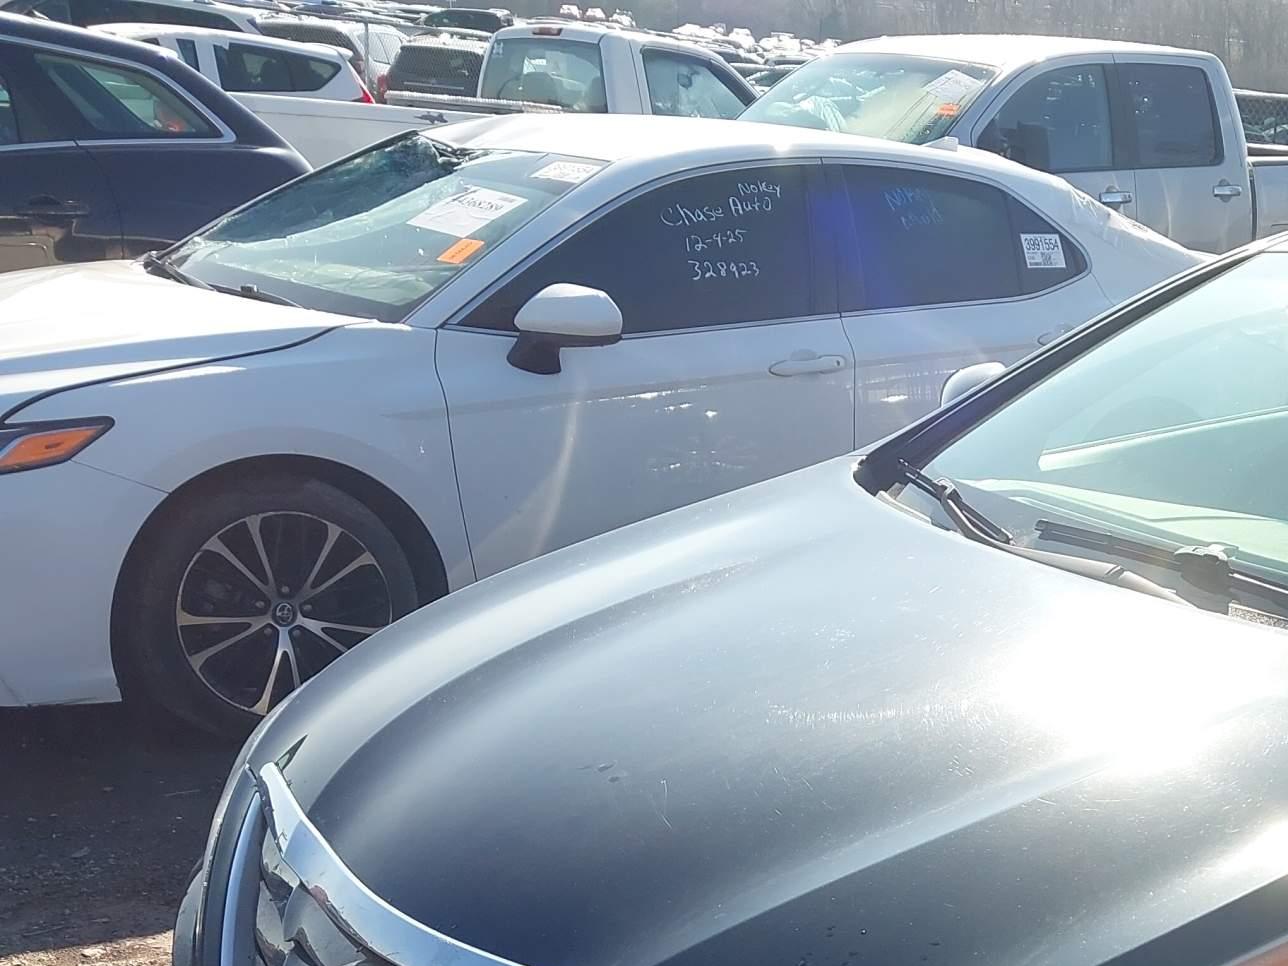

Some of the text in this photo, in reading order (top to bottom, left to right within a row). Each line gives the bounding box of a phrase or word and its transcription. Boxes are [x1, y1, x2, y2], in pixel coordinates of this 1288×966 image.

[660, 196, 772, 226] Chase Auto
[688, 260, 760, 280] 328923
